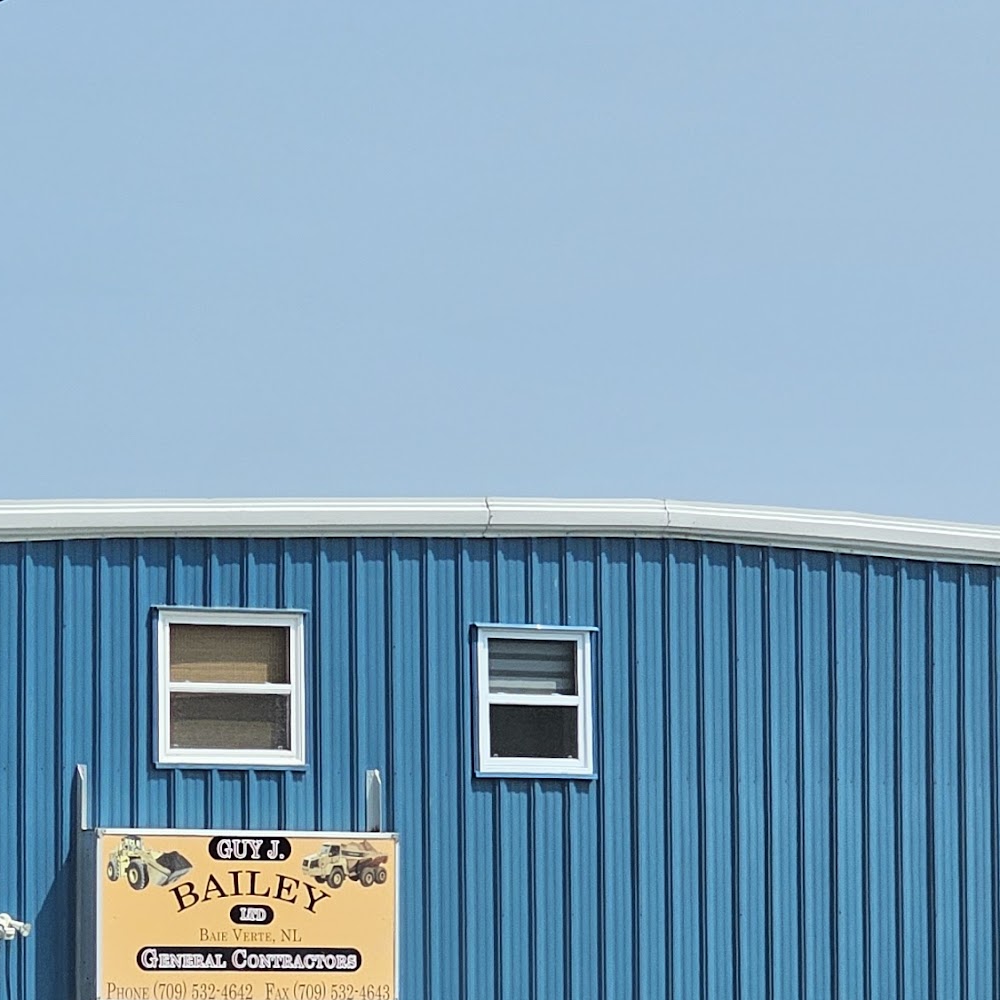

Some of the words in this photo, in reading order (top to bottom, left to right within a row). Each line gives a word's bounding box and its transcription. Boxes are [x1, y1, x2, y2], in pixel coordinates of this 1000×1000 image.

[216, 839, 264, 859] GUY
[267, 839, 285, 860] J.
[169, 871, 331, 914] BAILEY
[239, 907, 266, 922] LTD
[281, 929, 301, 942] NL
[141, 948, 227, 969] GENERAL
[231, 949, 358, 969] CONTRACTORS
[107, 982, 150, 1000] PHONE
[154, 983, 187, 1000] (709)
[192, 984, 253, 1000] 532-4642
[293, 983, 327, 1000] (709)
[330, 984, 390, 1000] 532-4643
